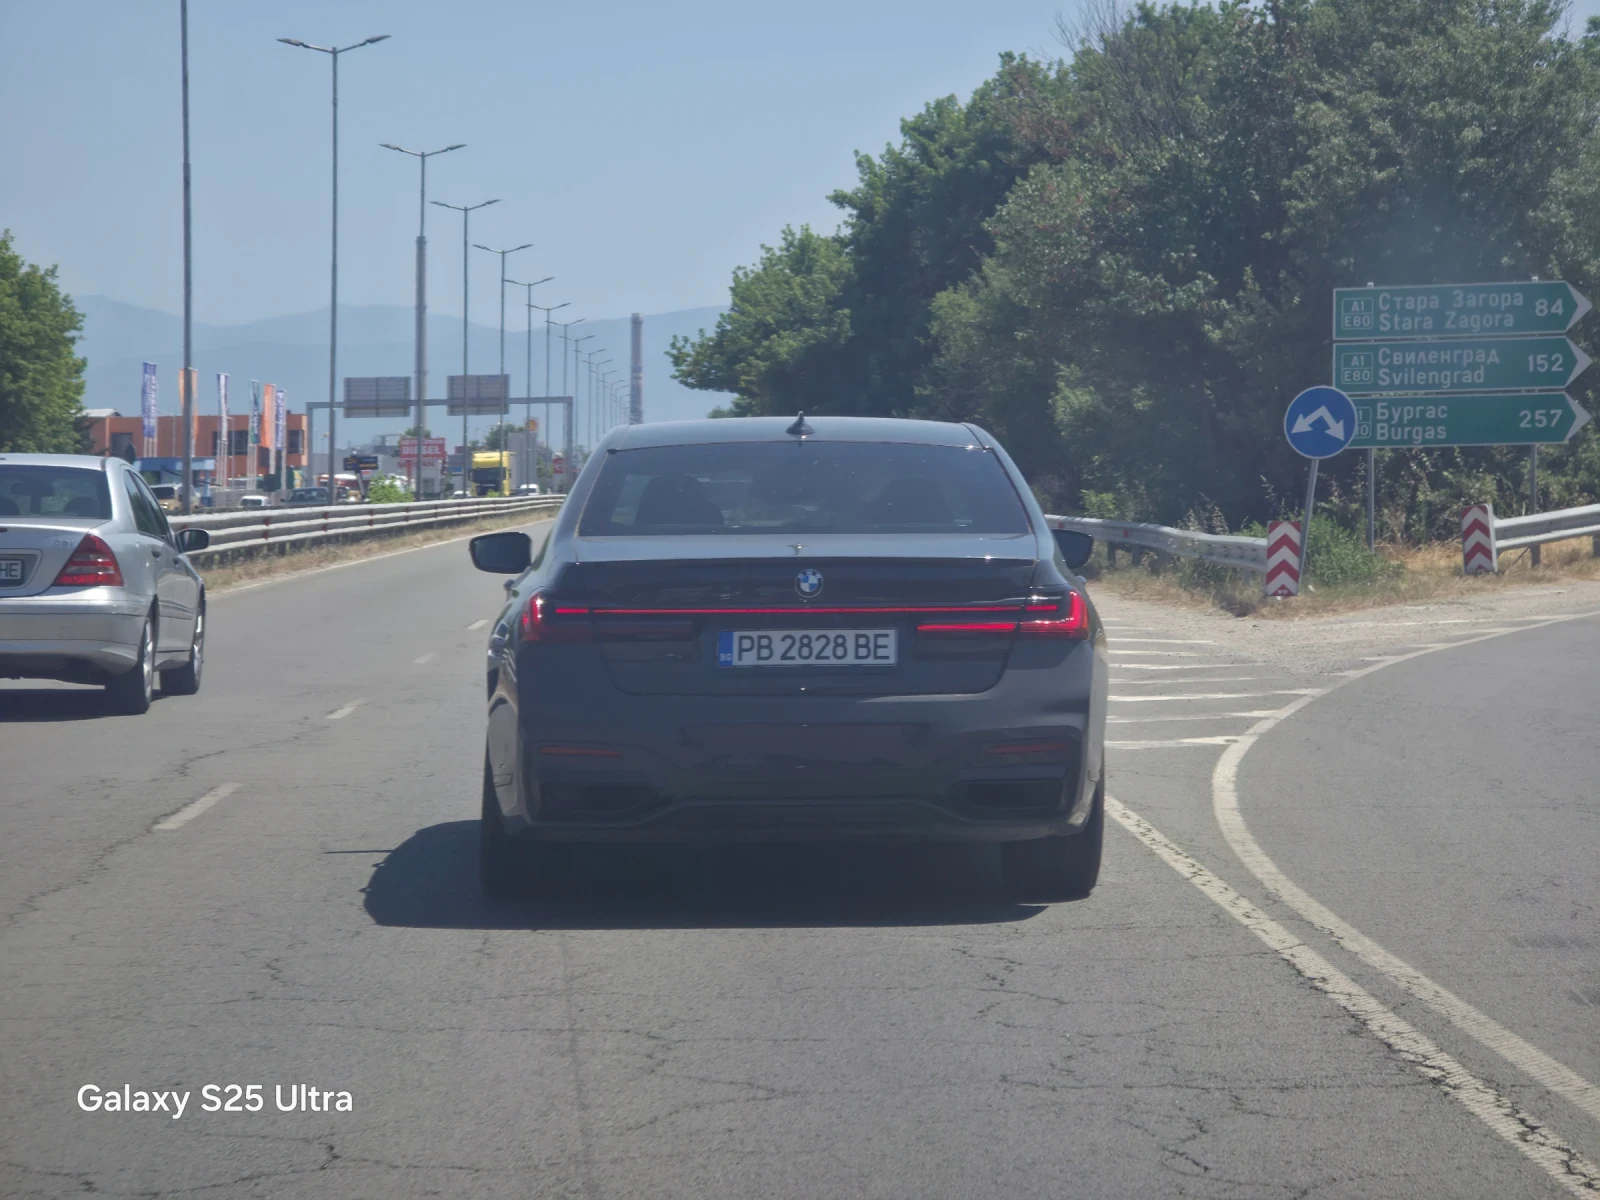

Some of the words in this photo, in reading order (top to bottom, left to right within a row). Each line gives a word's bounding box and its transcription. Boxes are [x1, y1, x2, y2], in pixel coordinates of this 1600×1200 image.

[1351, 300, 1365, 311] A1
[1378, 292, 1440, 312] Стара
[1453, 290, 1524, 311] Загора
[1535, 298, 1564, 317] 84
[1344, 316, 1371, 327] E80
[1378, 313, 1433, 331] Stara
[1444, 311, 1514, 332] Zagora
[1351, 355, 1365, 366] A1
[1378, 347, 1499, 368] Свиленград
[1528, 353, 1564, 373] 152
[1344, 371, 1371, 382] E80
[1378, 366, 1485, 388] Svilengrad
[1376, 402, 1448, 424] Бургас
[1519, 409, 1563, 428] 257
[1376, 423, 1447, 444] Burgas
[719, 653, 733, 661] BG
[738, 634, 773, 662] PB
[780, 634, 848, 661] 2828
[854, 633, 890, 660] BE
